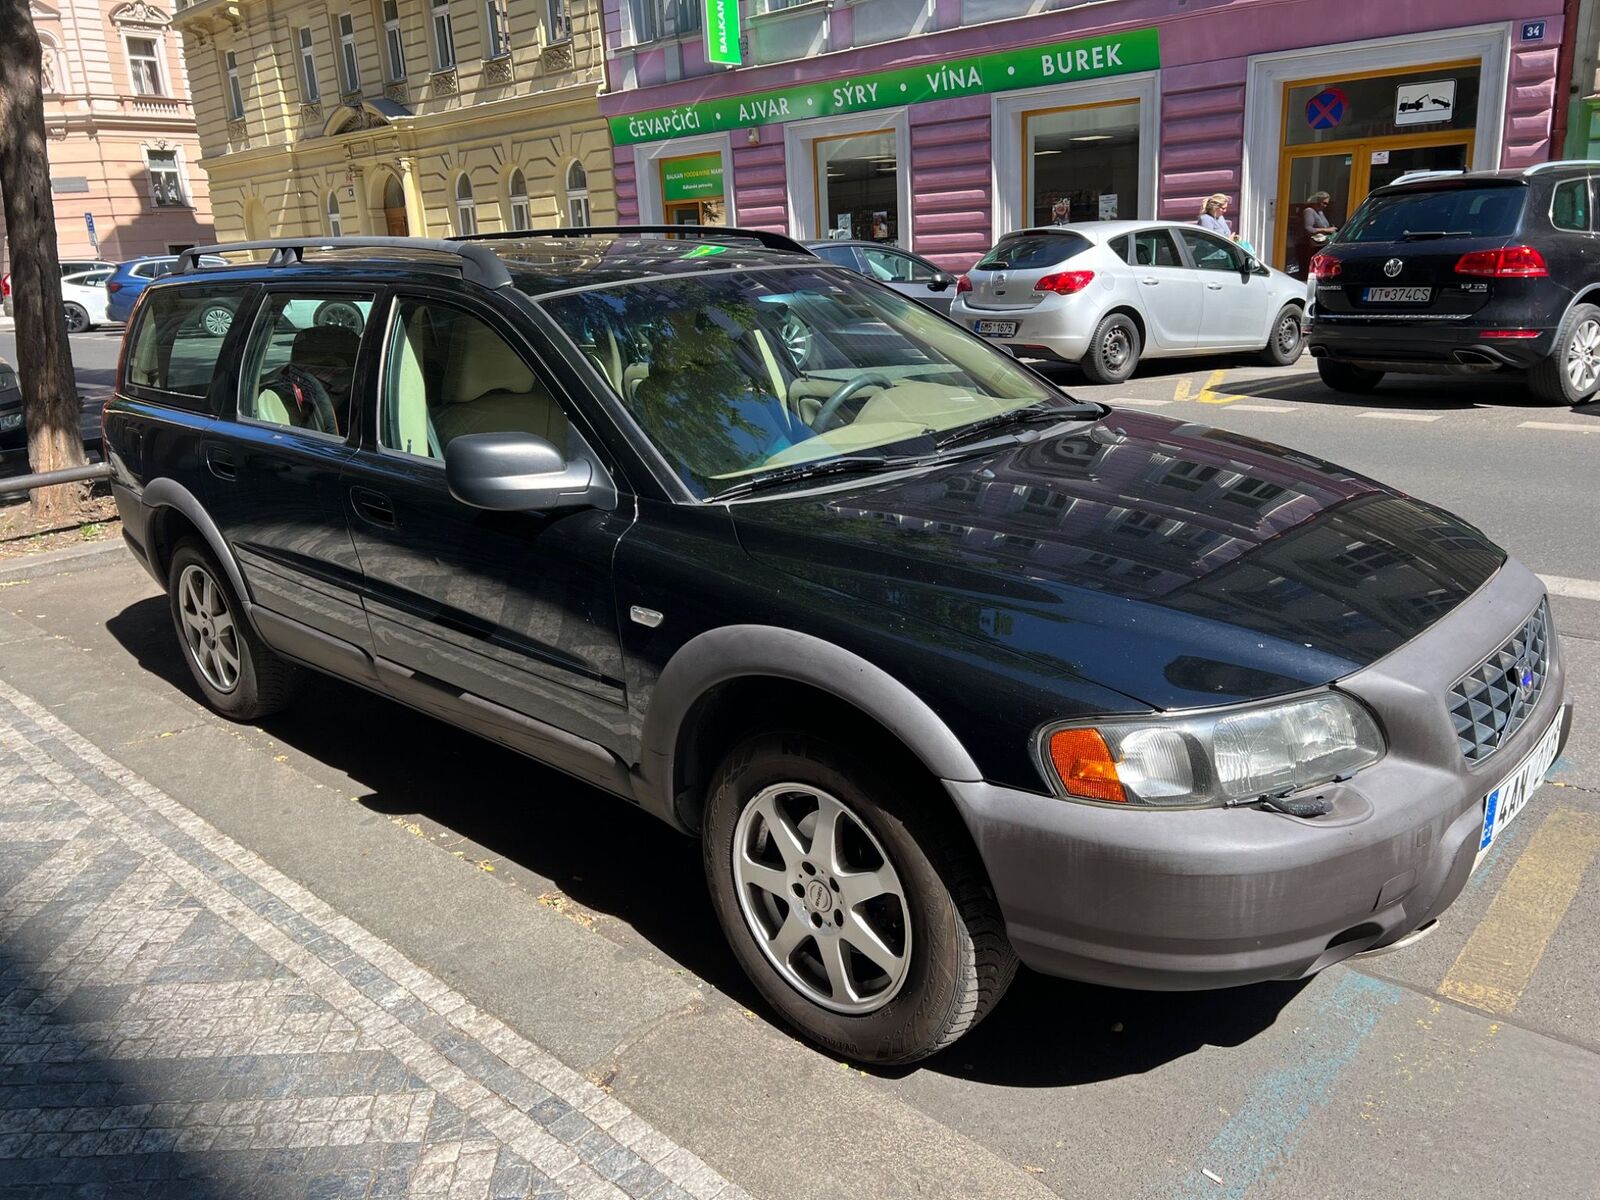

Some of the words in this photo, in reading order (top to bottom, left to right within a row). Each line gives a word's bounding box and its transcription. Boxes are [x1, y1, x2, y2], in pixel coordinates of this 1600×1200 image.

[717, 0, 728, 53] BALKAN
[1527, 25, 1540, 37] 34
[629, 107, 700, 138] ČEVAPČIČI
[739, 97, 790, 122] AJVAR
[833, 81, 878, 107] SÝRY
[926, 65, 982, 93] VÍNA
[1041, 43, 1123, 77] BUREK
[1370, 288, 1385, 301] VT
[1390, 288, 1430, 301] 374CS
